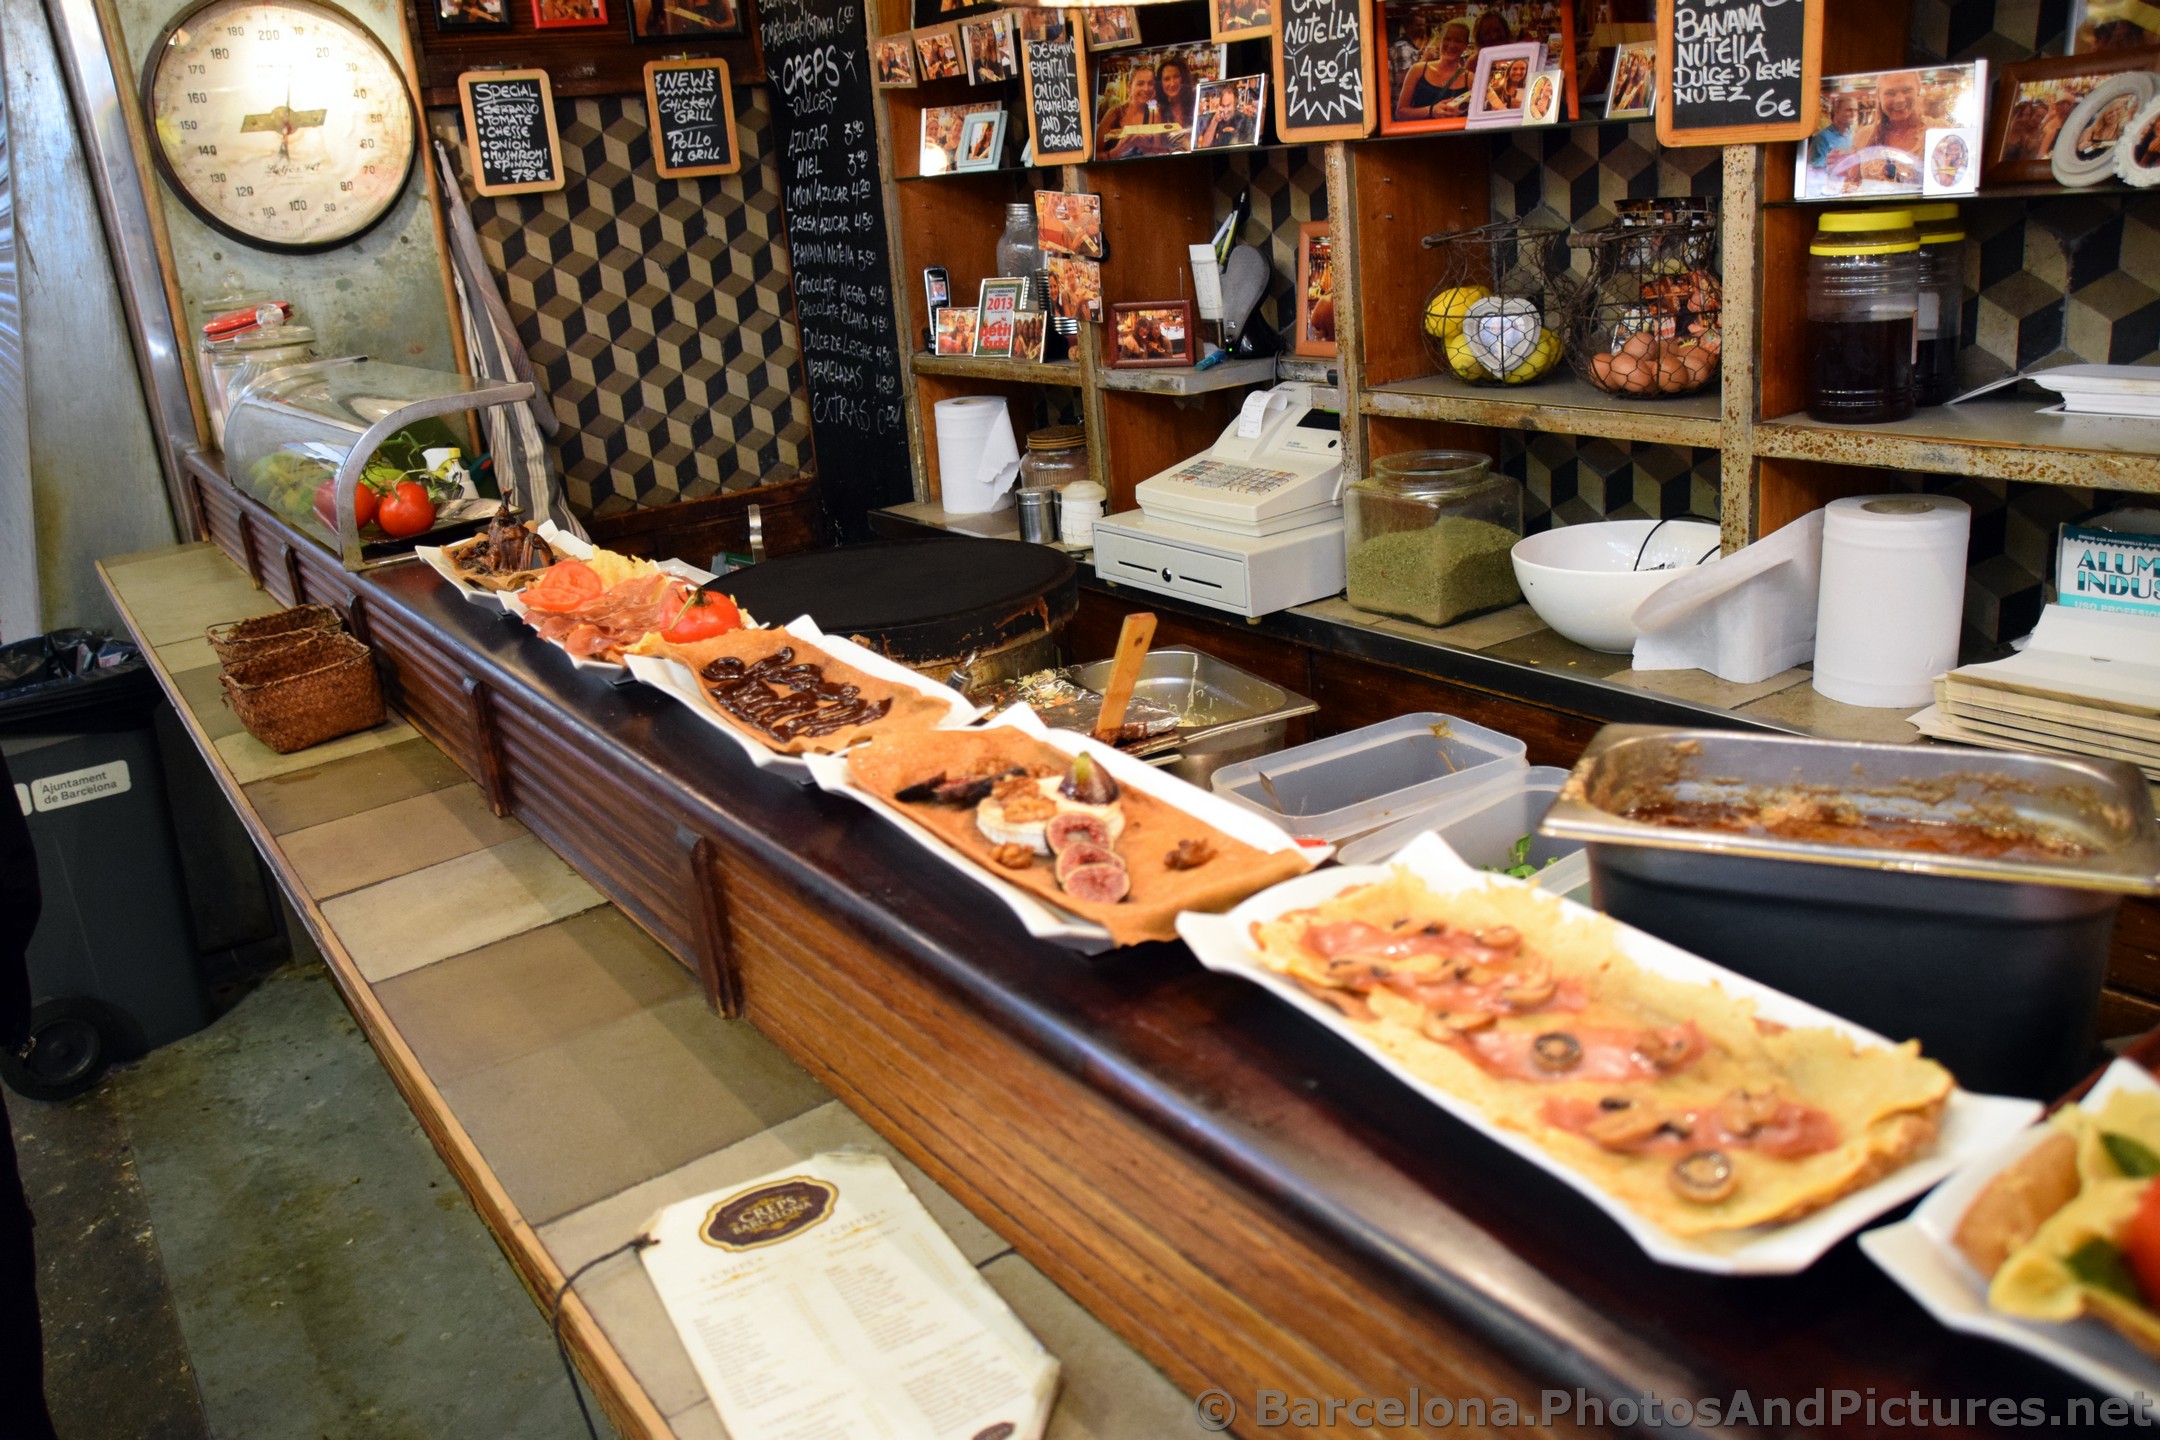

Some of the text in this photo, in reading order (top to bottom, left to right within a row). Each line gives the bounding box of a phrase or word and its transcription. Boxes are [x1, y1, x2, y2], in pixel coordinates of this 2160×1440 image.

[294, 26, 304, 35] 10
[1284, 9, 1359, 45] NUTELLA
[1674, 4, 1767, 43] BANANA
[258, 30, 280, 41] 200
[211, 48, 230, 60] 180
[316, 47, 330, 58] 20
[1677, 33, 1770, 69] NUTELLA
[188, 64, 206, 75] 170
[1030, 57, 1076, 81] EMENTAL
[1755, 57, 1802, 81] LECHE
[663, 70, 706, 90] NEW
[1033, 78, 1071, 99] ONION
[187, 92, 207, 104] 160
[353, 88, 367, 99] 40
[475, 82, 538, 104] SPECIAL
[1674, 86, 1752, 105] NUEZ
[659, 94, 717, 114] CHICKEN
[180, 120, 198, 130] 150
[370, 113, 383, 123] 50
[483, 114, 533, 126] TOMATE
[674, 109, 713, 124] GRILL
[1040, 115, 1061, 133] AND
[488, 138, 531, 150] ONION
[667, 131, 711, 150] POLLO
[787, 123, 829, 161] AZUCAR
[1043, 130, 1083, 148] OREGANO
[671, 146, 720, 168] AL GRILL
[363, 165, 376, 175] 70
[796, 154, 823, 179] MIEL
[210, 173, 227, 183] 130
[235, 186, 254, 197] 120
[289, 200, 308, 212] 100
[986, 296, 1014, 311] 2013
[41, 771, 108, 795] Ajuntament
[44, 780, 118, 805] de Barcelona
[732, 1201, 813, 1235] BARCELONA
[739, 1195, 797, 1223] CREPS
